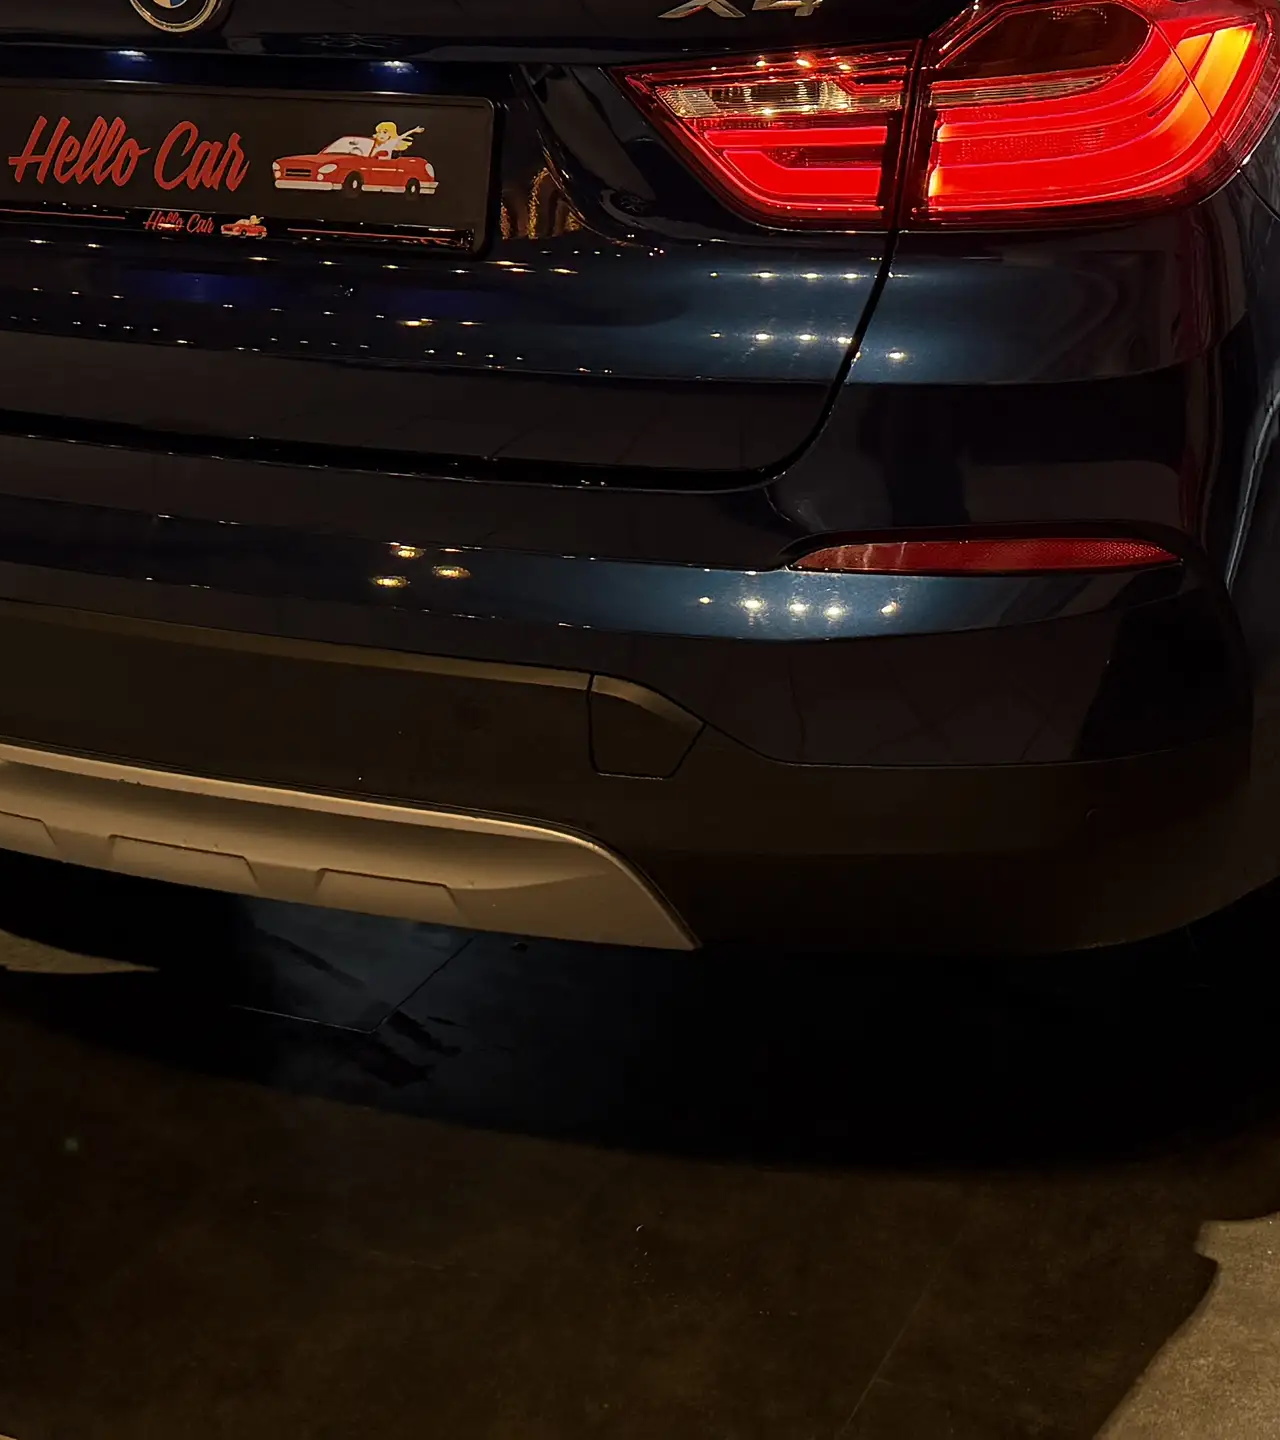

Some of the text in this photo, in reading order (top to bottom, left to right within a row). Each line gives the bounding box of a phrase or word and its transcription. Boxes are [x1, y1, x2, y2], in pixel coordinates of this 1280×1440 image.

[8, 115, 251, 192] Hello Car
[143, 211, 216, 234] Hello Car
